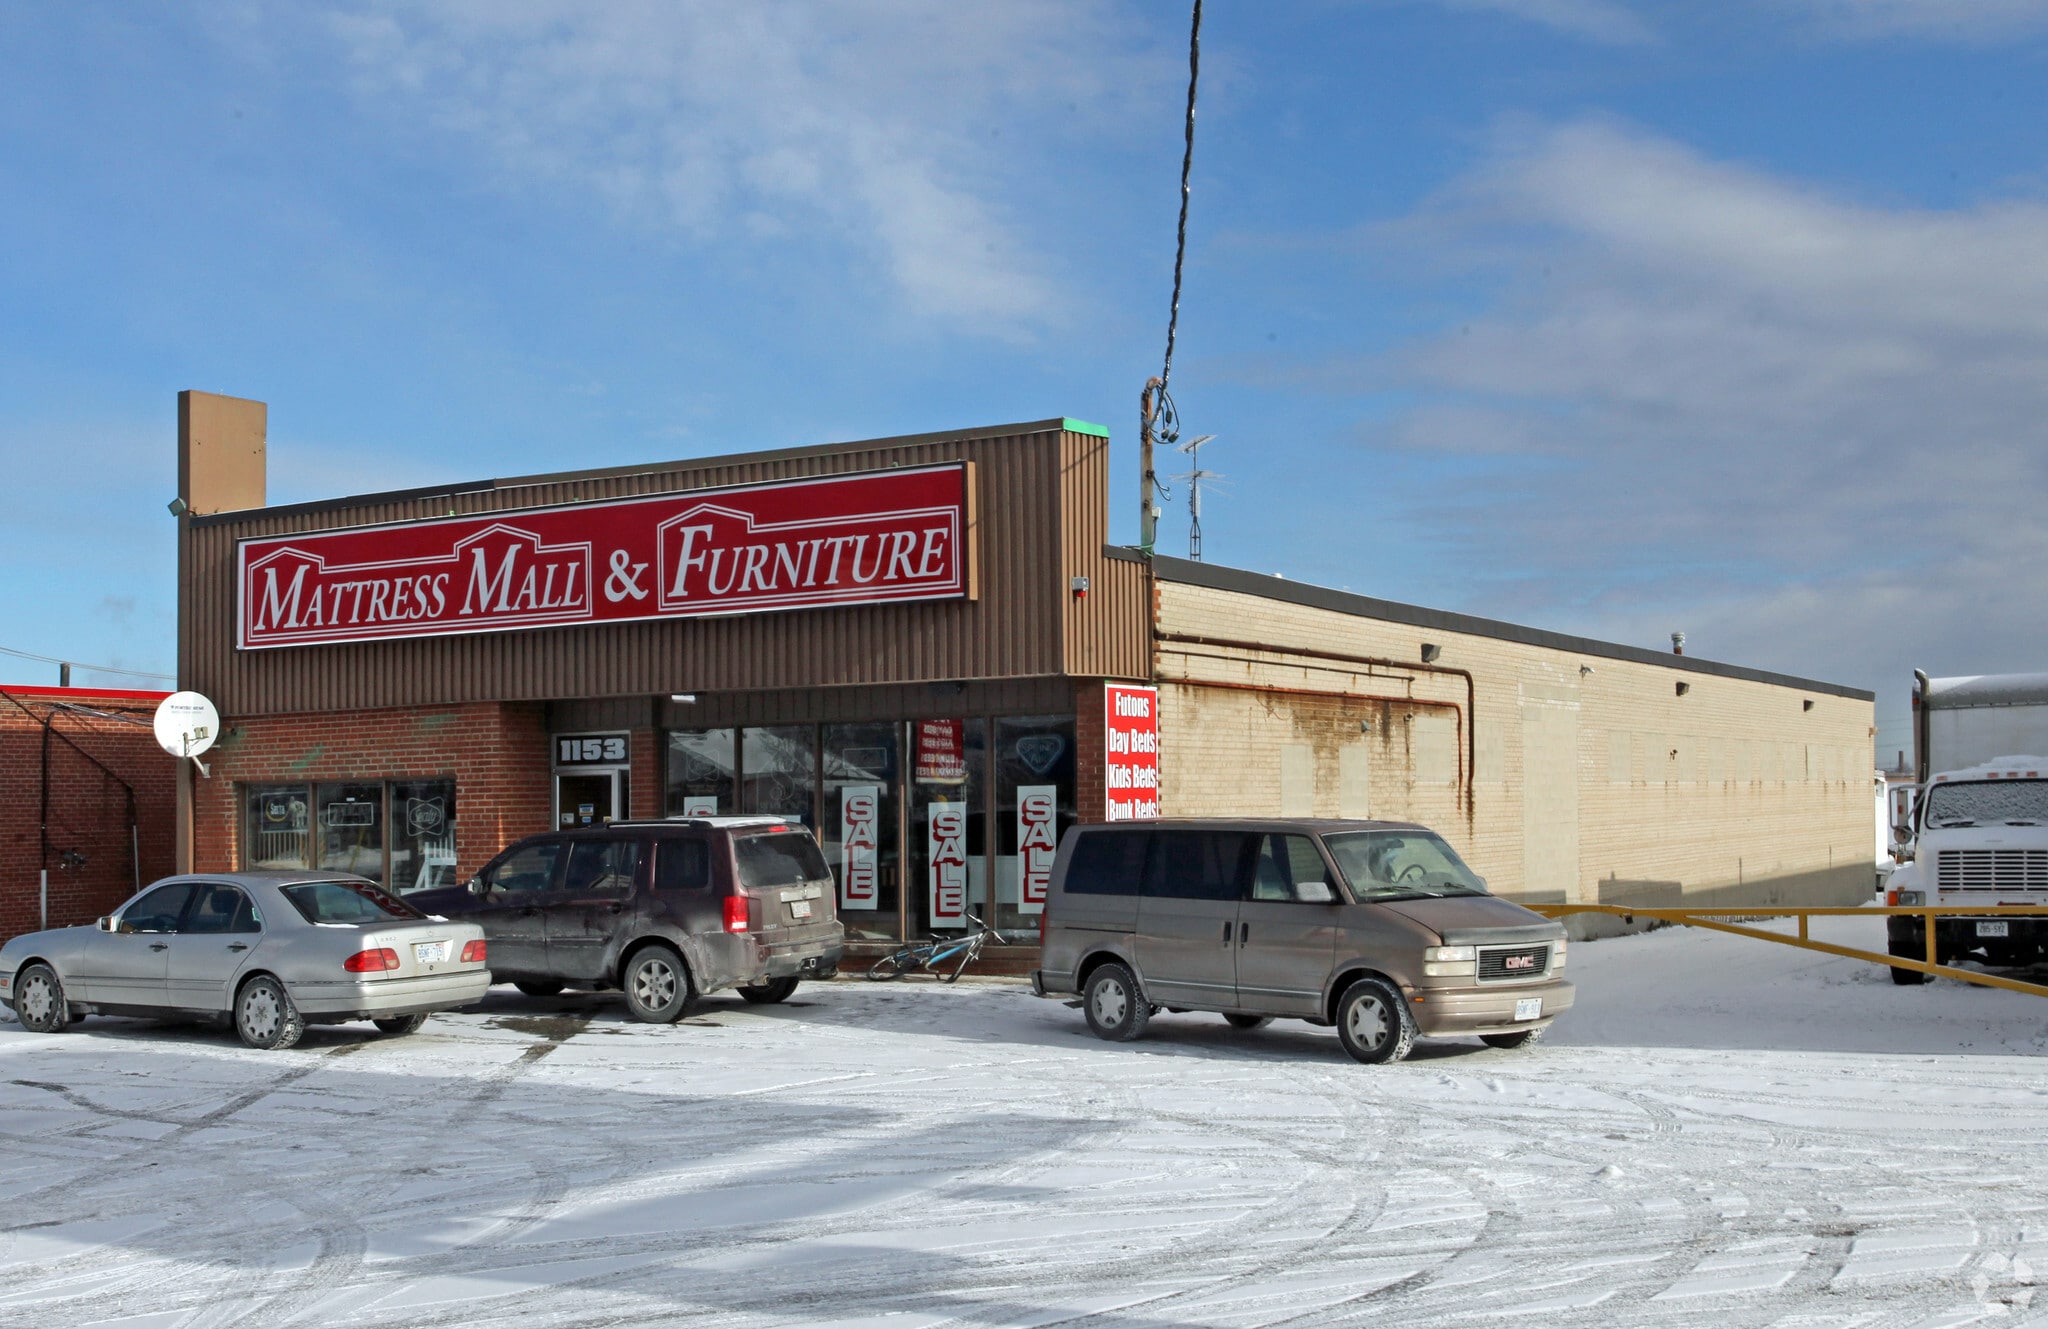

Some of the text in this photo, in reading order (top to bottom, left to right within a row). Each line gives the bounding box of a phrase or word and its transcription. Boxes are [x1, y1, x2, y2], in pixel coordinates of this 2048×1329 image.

[253, 523, 949, 631] MATTRESS MALL & FURNITURE
[1115, 691, 1150, 718] Futons
[560, 738, 626, 762] 1153
[1109, 727, 1156, 755] Day Beds
[1108, 764, 1156, 789] Kids Beds
[1109, 798, 1157, 821] Bunk Beds
[846, 795, 876, 900] SALE
[1020, 794, 1055, 904] SALE
[932, 810, 965, 918] SALE
[1505, 955, 1535, 969] GMC
